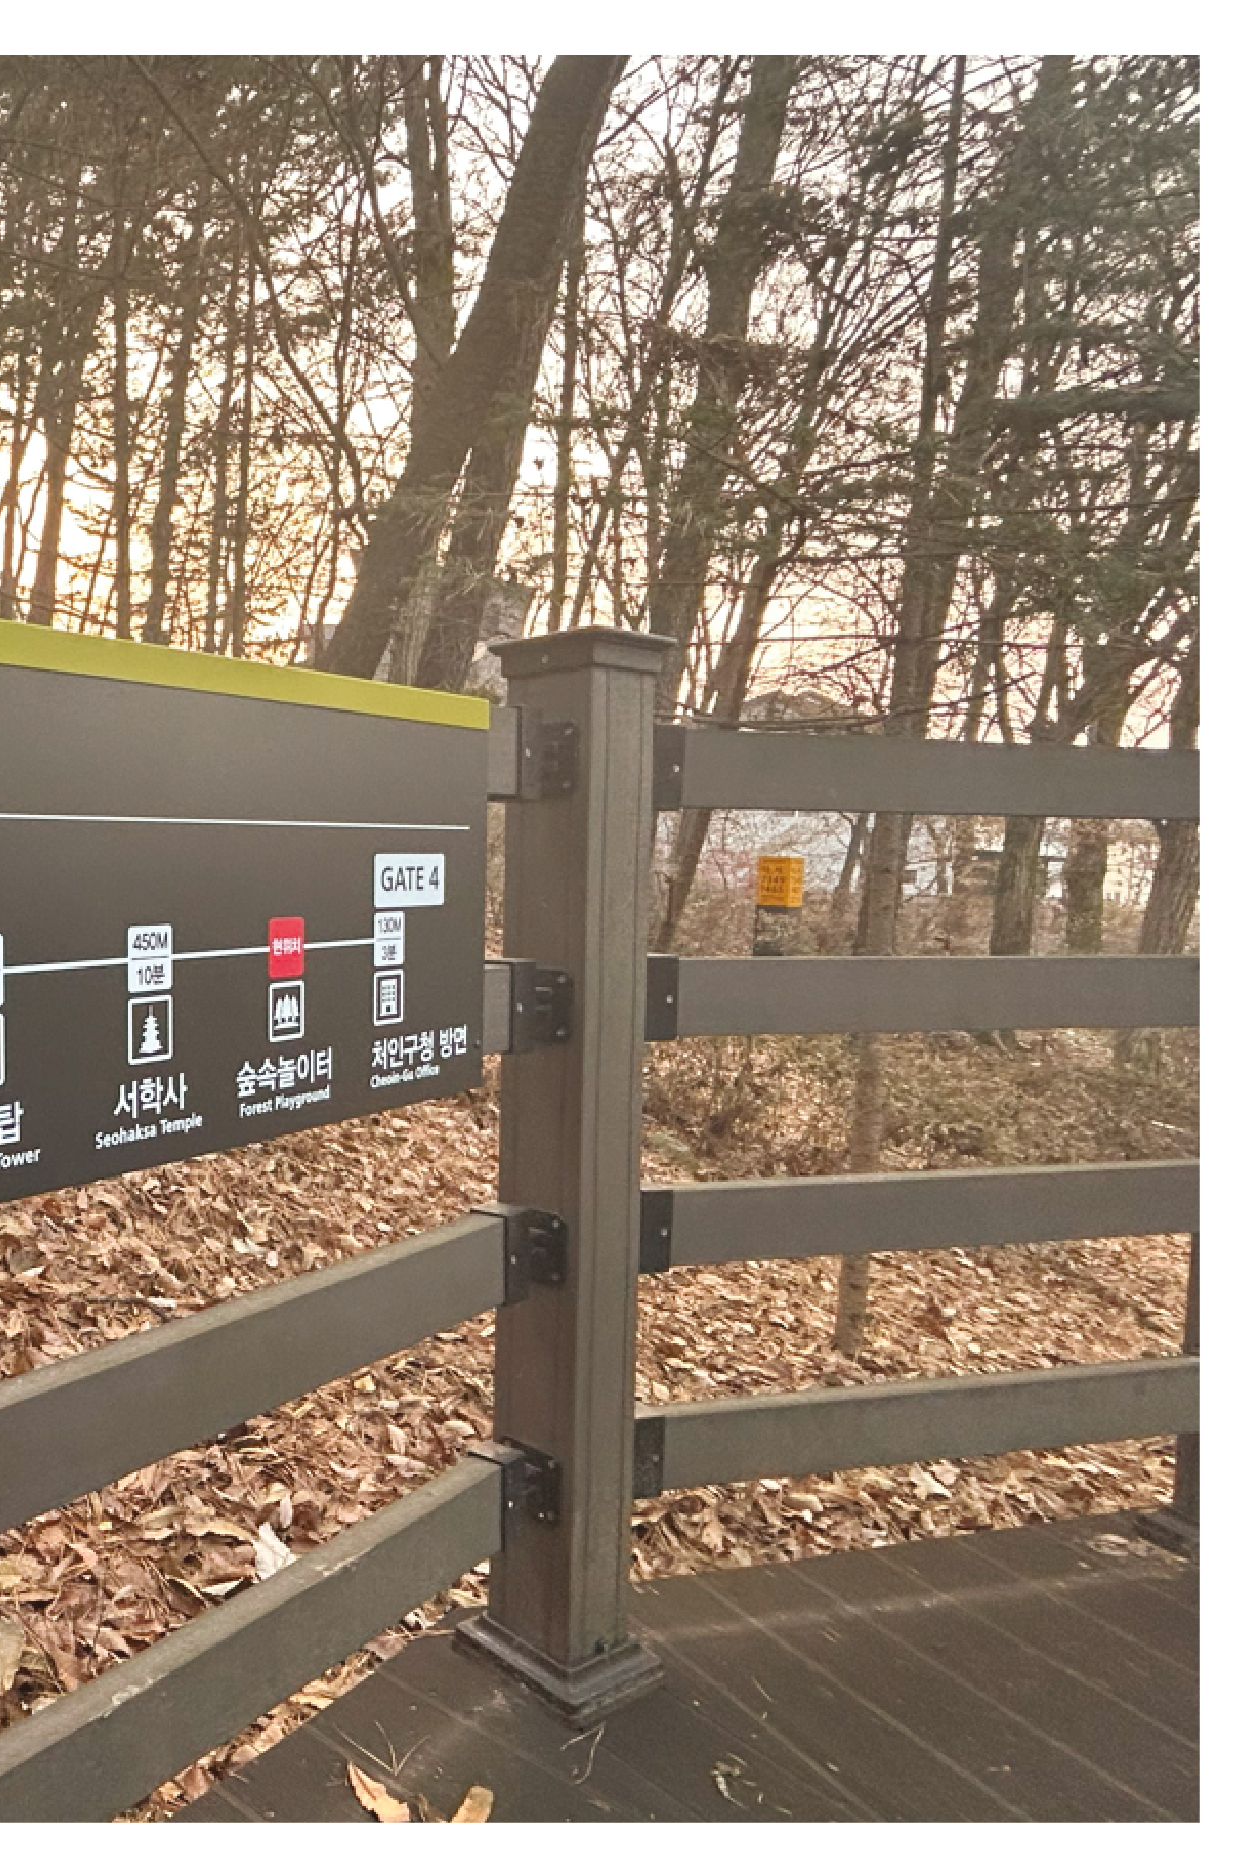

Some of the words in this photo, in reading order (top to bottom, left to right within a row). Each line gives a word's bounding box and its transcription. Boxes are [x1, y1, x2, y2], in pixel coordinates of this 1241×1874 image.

[381, 866, 424, 892] GATE
[429, 866, 440, 890] 4
[132, 932, 168, 950] 450M
[377, 917, 402, 934] 130M
[136, 964, 165, 986] 10분
[371, 1029, 435, 1070] 처인구청
[439, 1023, 467, 1059] 방면
[236, 1045, 333, 1099] 숲속놀이터
[113, 1072, 188, 1119] 서학사
[95, 1123, 158, 1149] Seohaksa
[159, 1112, 203, 1135] Temple
